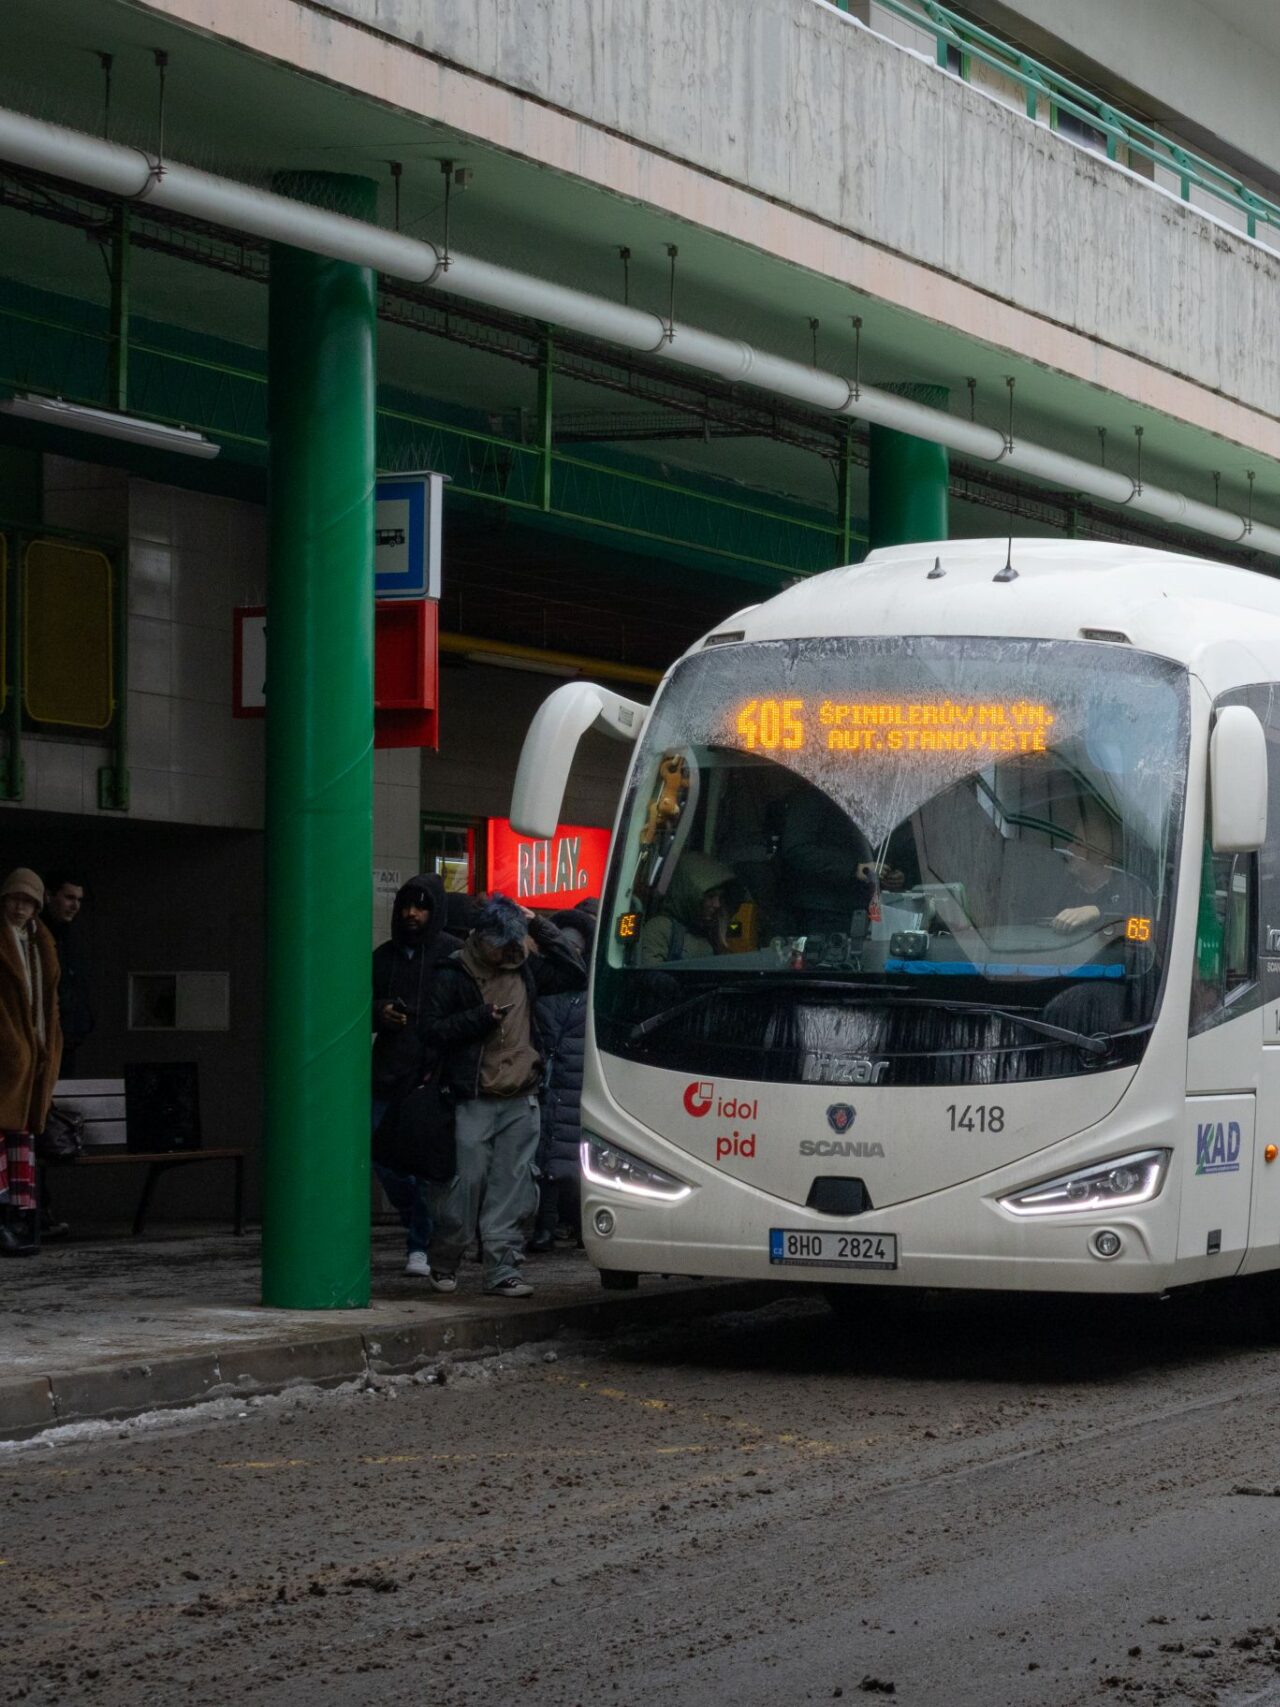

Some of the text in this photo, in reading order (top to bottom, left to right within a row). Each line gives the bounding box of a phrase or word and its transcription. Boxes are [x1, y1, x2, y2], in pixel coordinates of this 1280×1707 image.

[737, 700, 804, 749] 405
[1127, 918, 1151, 941] 65
[717, 1097, 758, 1120] idol
[946, 1104, 1005, 1133] 1418
[716, 1131, 756, 1161] pid
[799, 1140, 886, 1158] SCANIA
[1196, 1121, 1241, 1165] KAD
[838, 1237, 886, 1259] 2824
